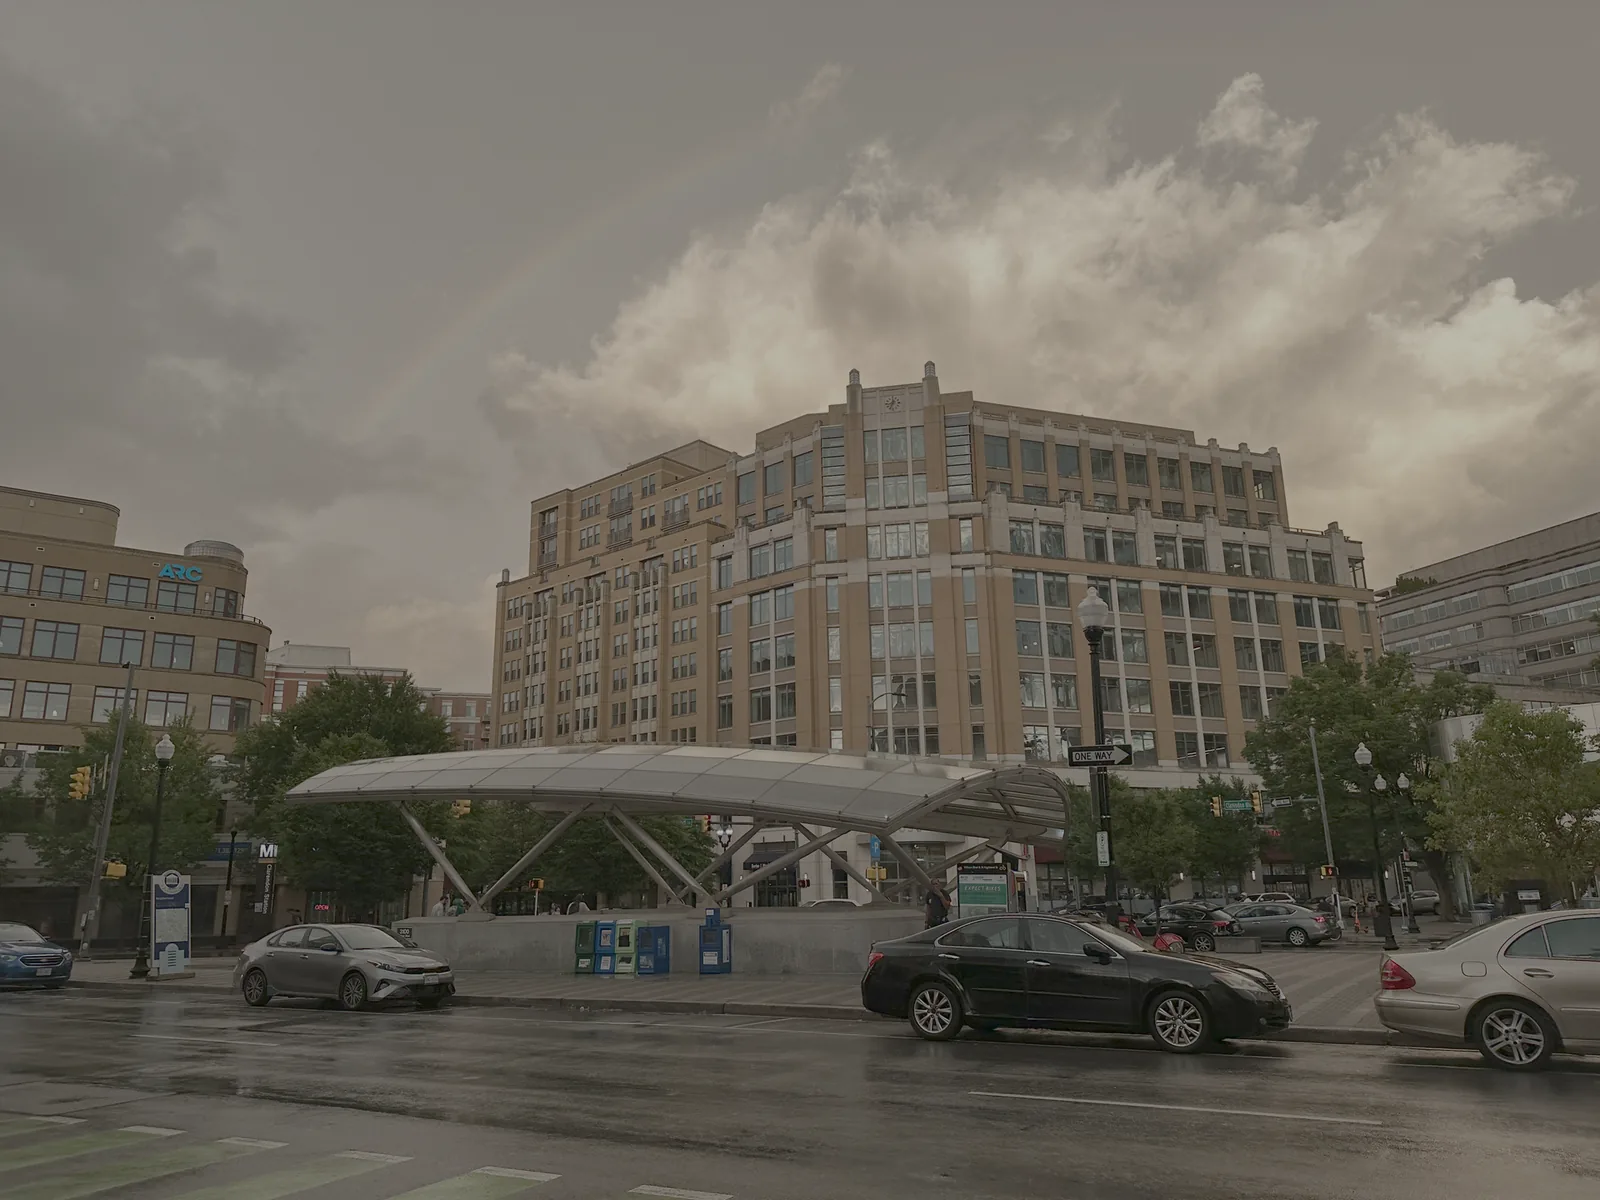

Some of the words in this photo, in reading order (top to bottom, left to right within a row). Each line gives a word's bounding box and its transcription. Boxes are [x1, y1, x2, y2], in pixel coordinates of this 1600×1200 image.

[158, 563, 202, 582] ARC
[1074, 752, 1092, 761] ONE
[1094, 751, 1113, 760] WAY
[259, 844, 274, 858] M
[264, 864, 273, 893] Clarendon
[262, 893, 270, 915] Station
